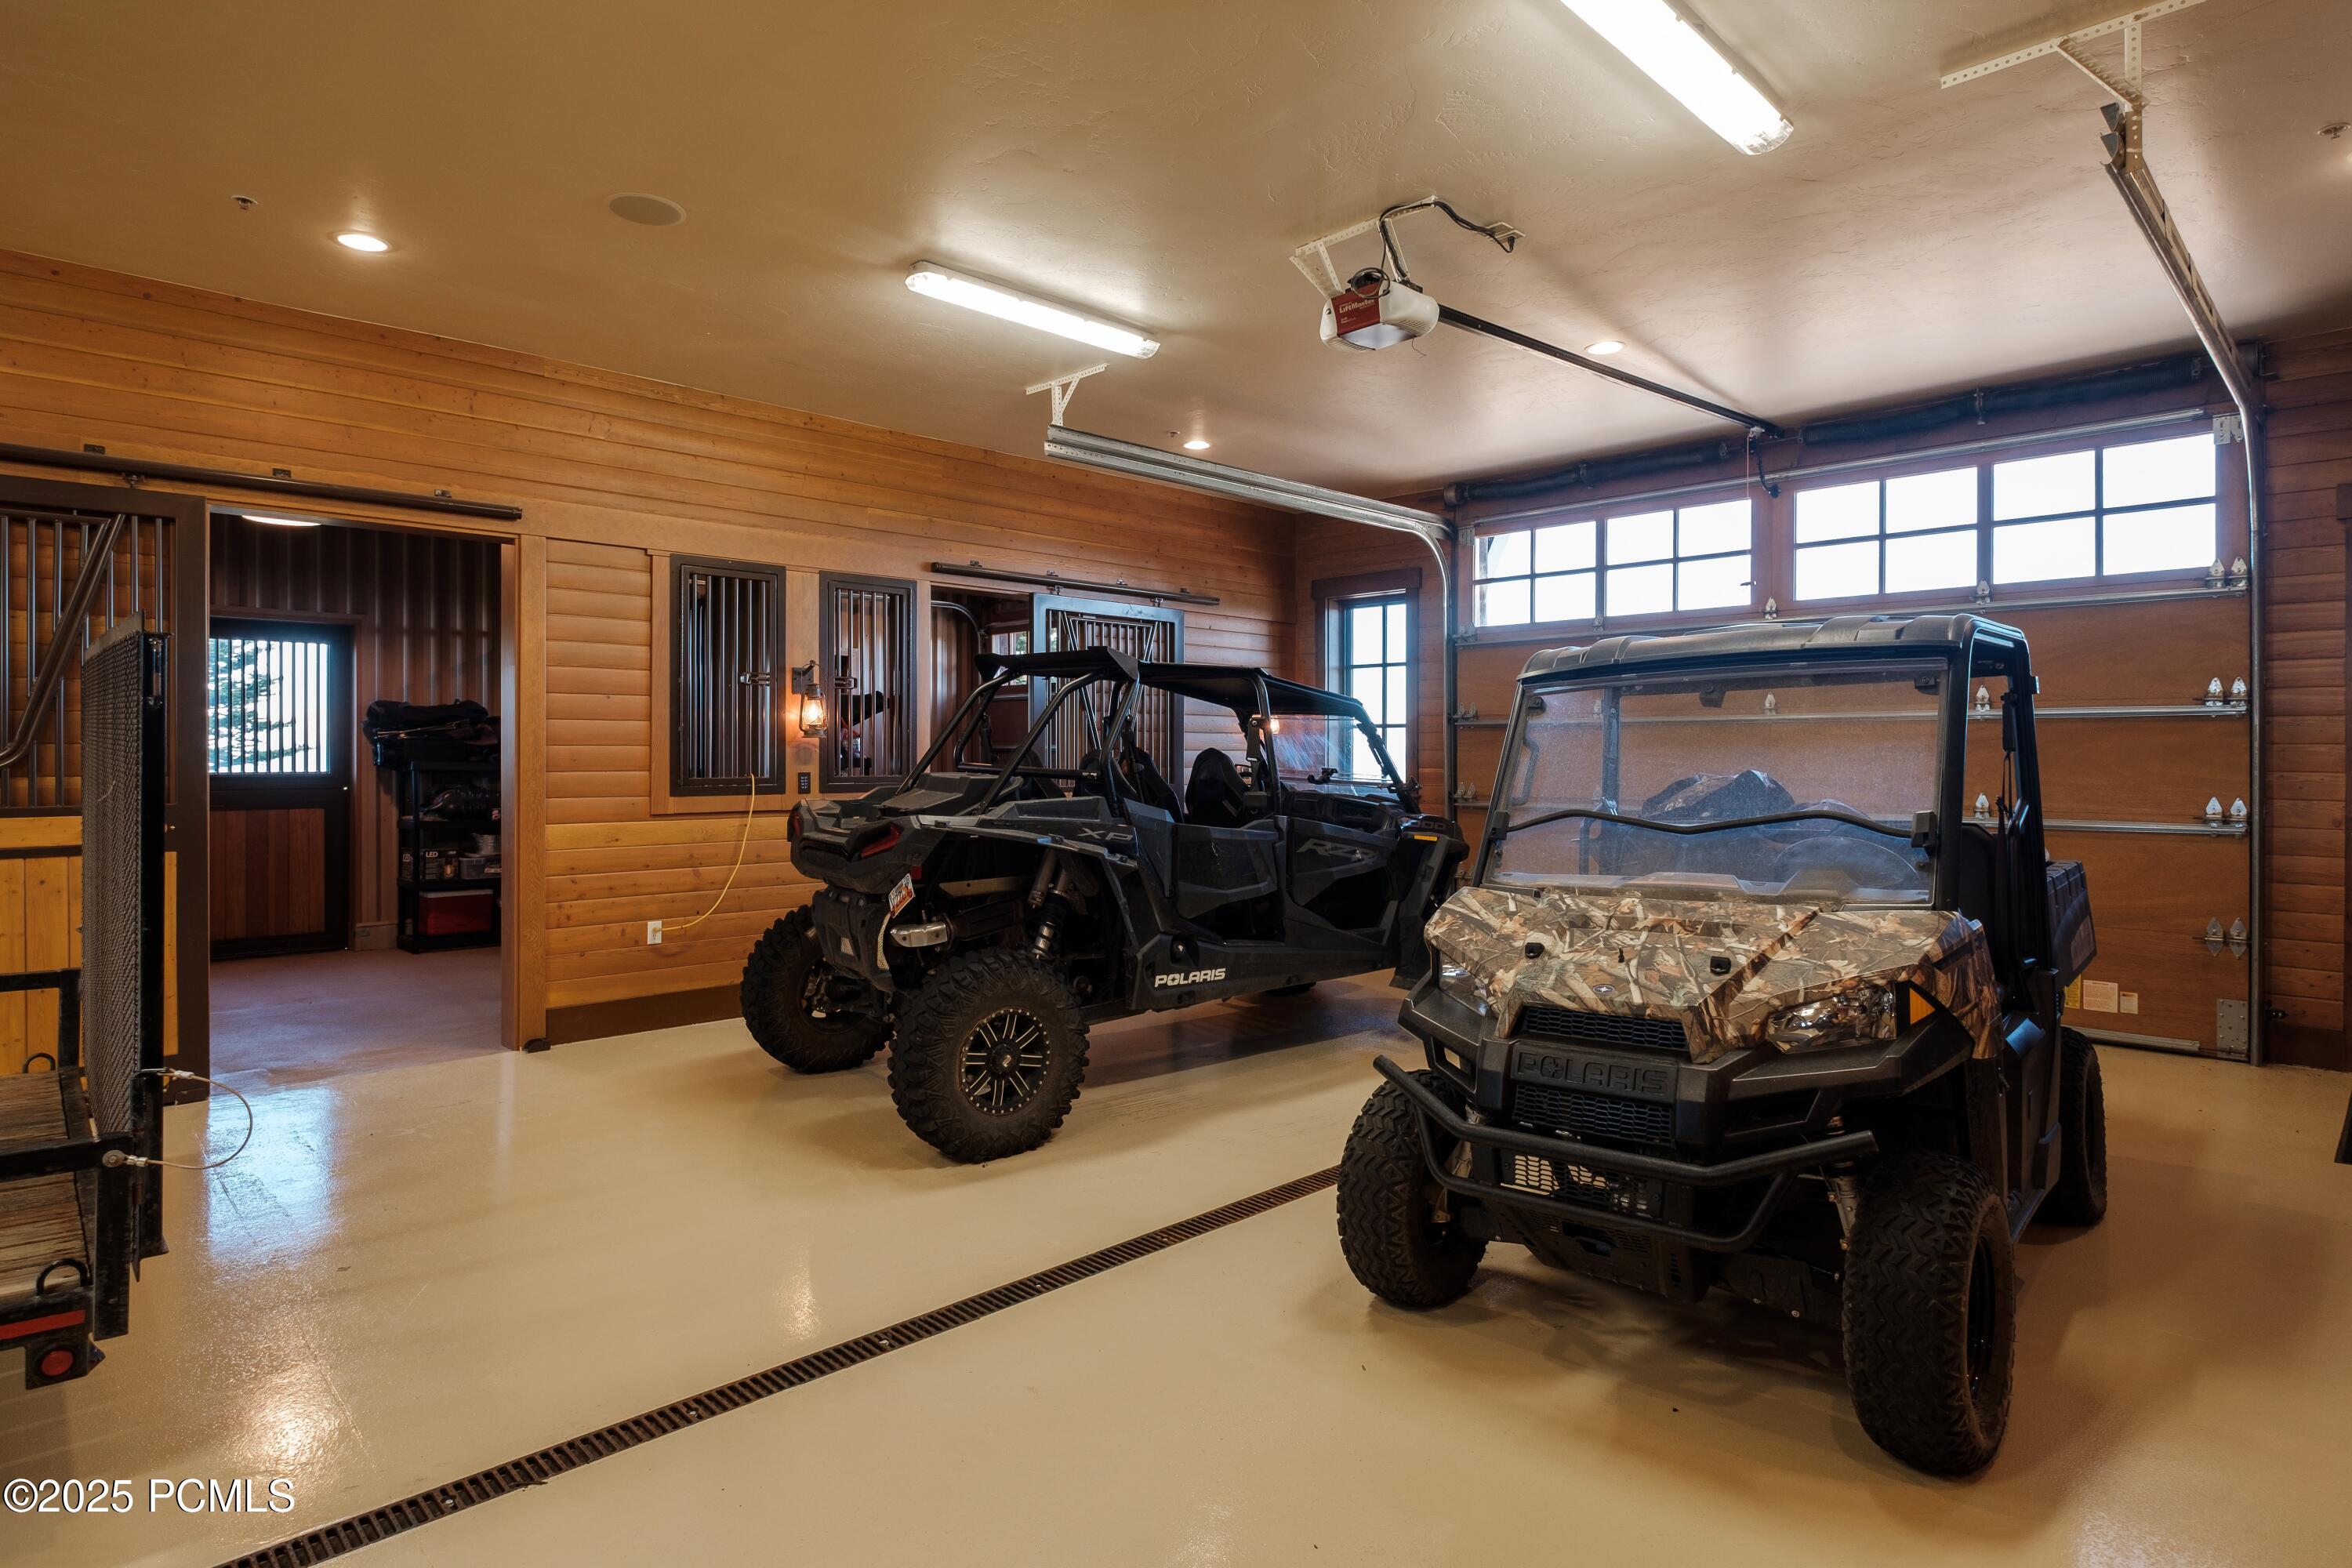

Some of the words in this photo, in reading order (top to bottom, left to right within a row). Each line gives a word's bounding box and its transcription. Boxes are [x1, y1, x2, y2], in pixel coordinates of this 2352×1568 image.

[1077, 827, 1134, 841] XP
[1297, 838, 1377, 861] RZR
[1154, 967, 1226, 988] POLARIS
[1517, 1052, 1668, 1095] POLARIS
